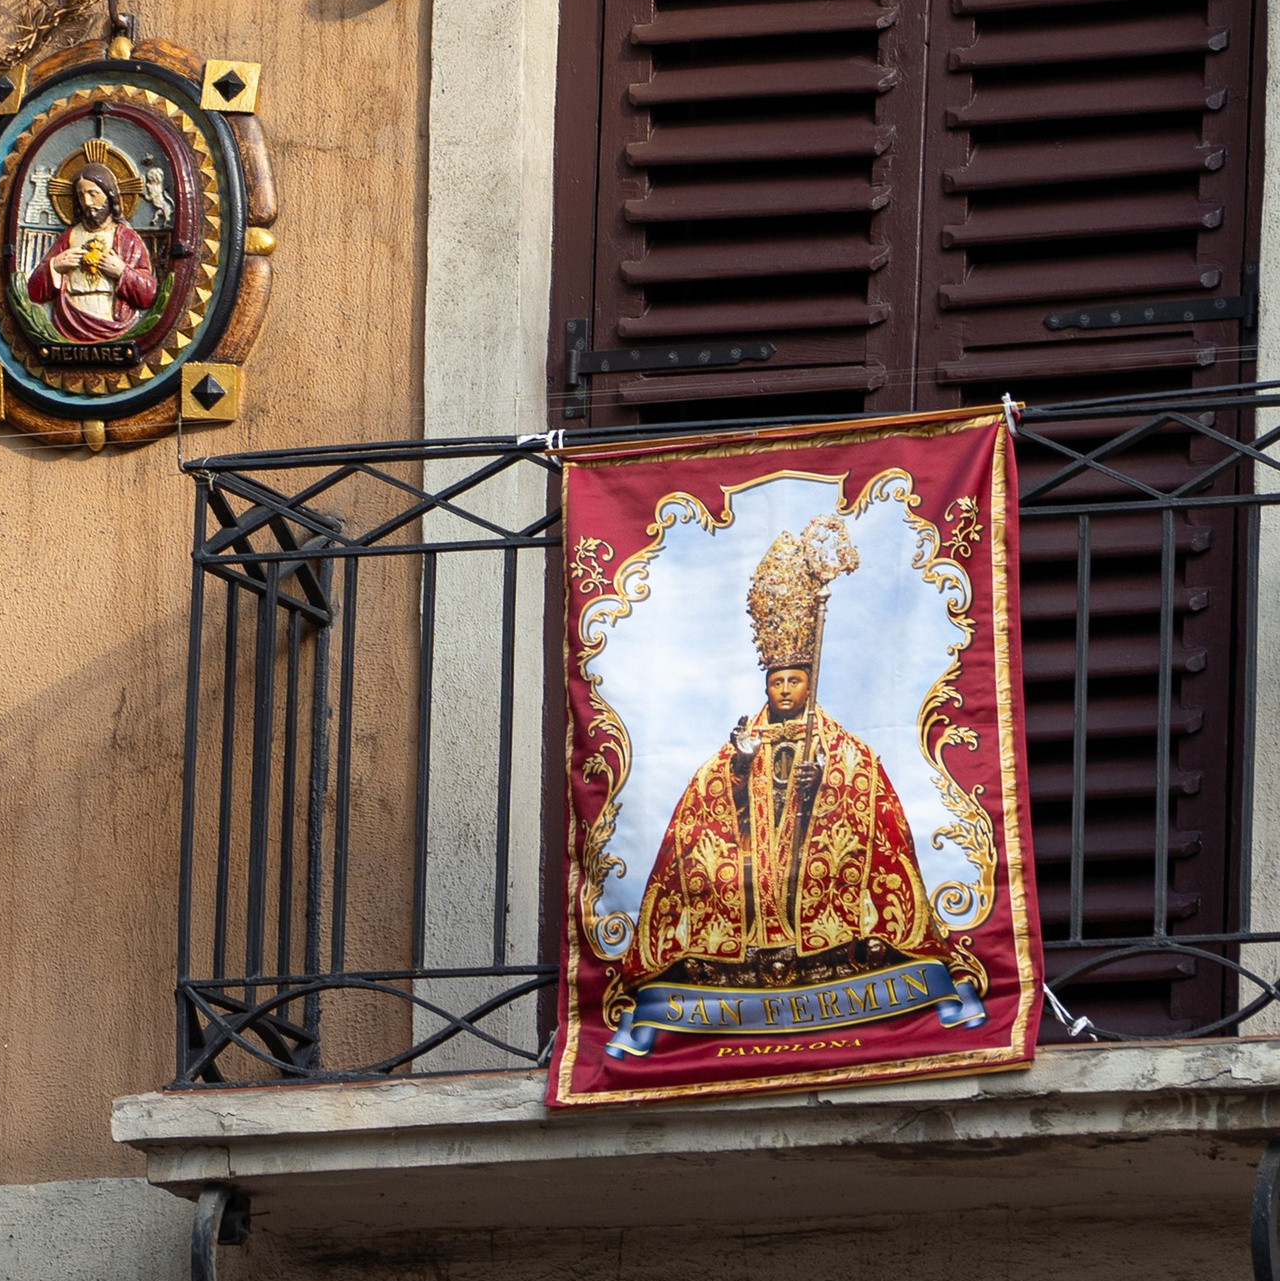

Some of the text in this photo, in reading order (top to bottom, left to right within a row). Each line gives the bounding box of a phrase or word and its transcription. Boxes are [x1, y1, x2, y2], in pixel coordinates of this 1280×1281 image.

[666, 969, 932, 1026] SAN FERMIN
[716, 1037, 863, 1058] PAMPLONA
